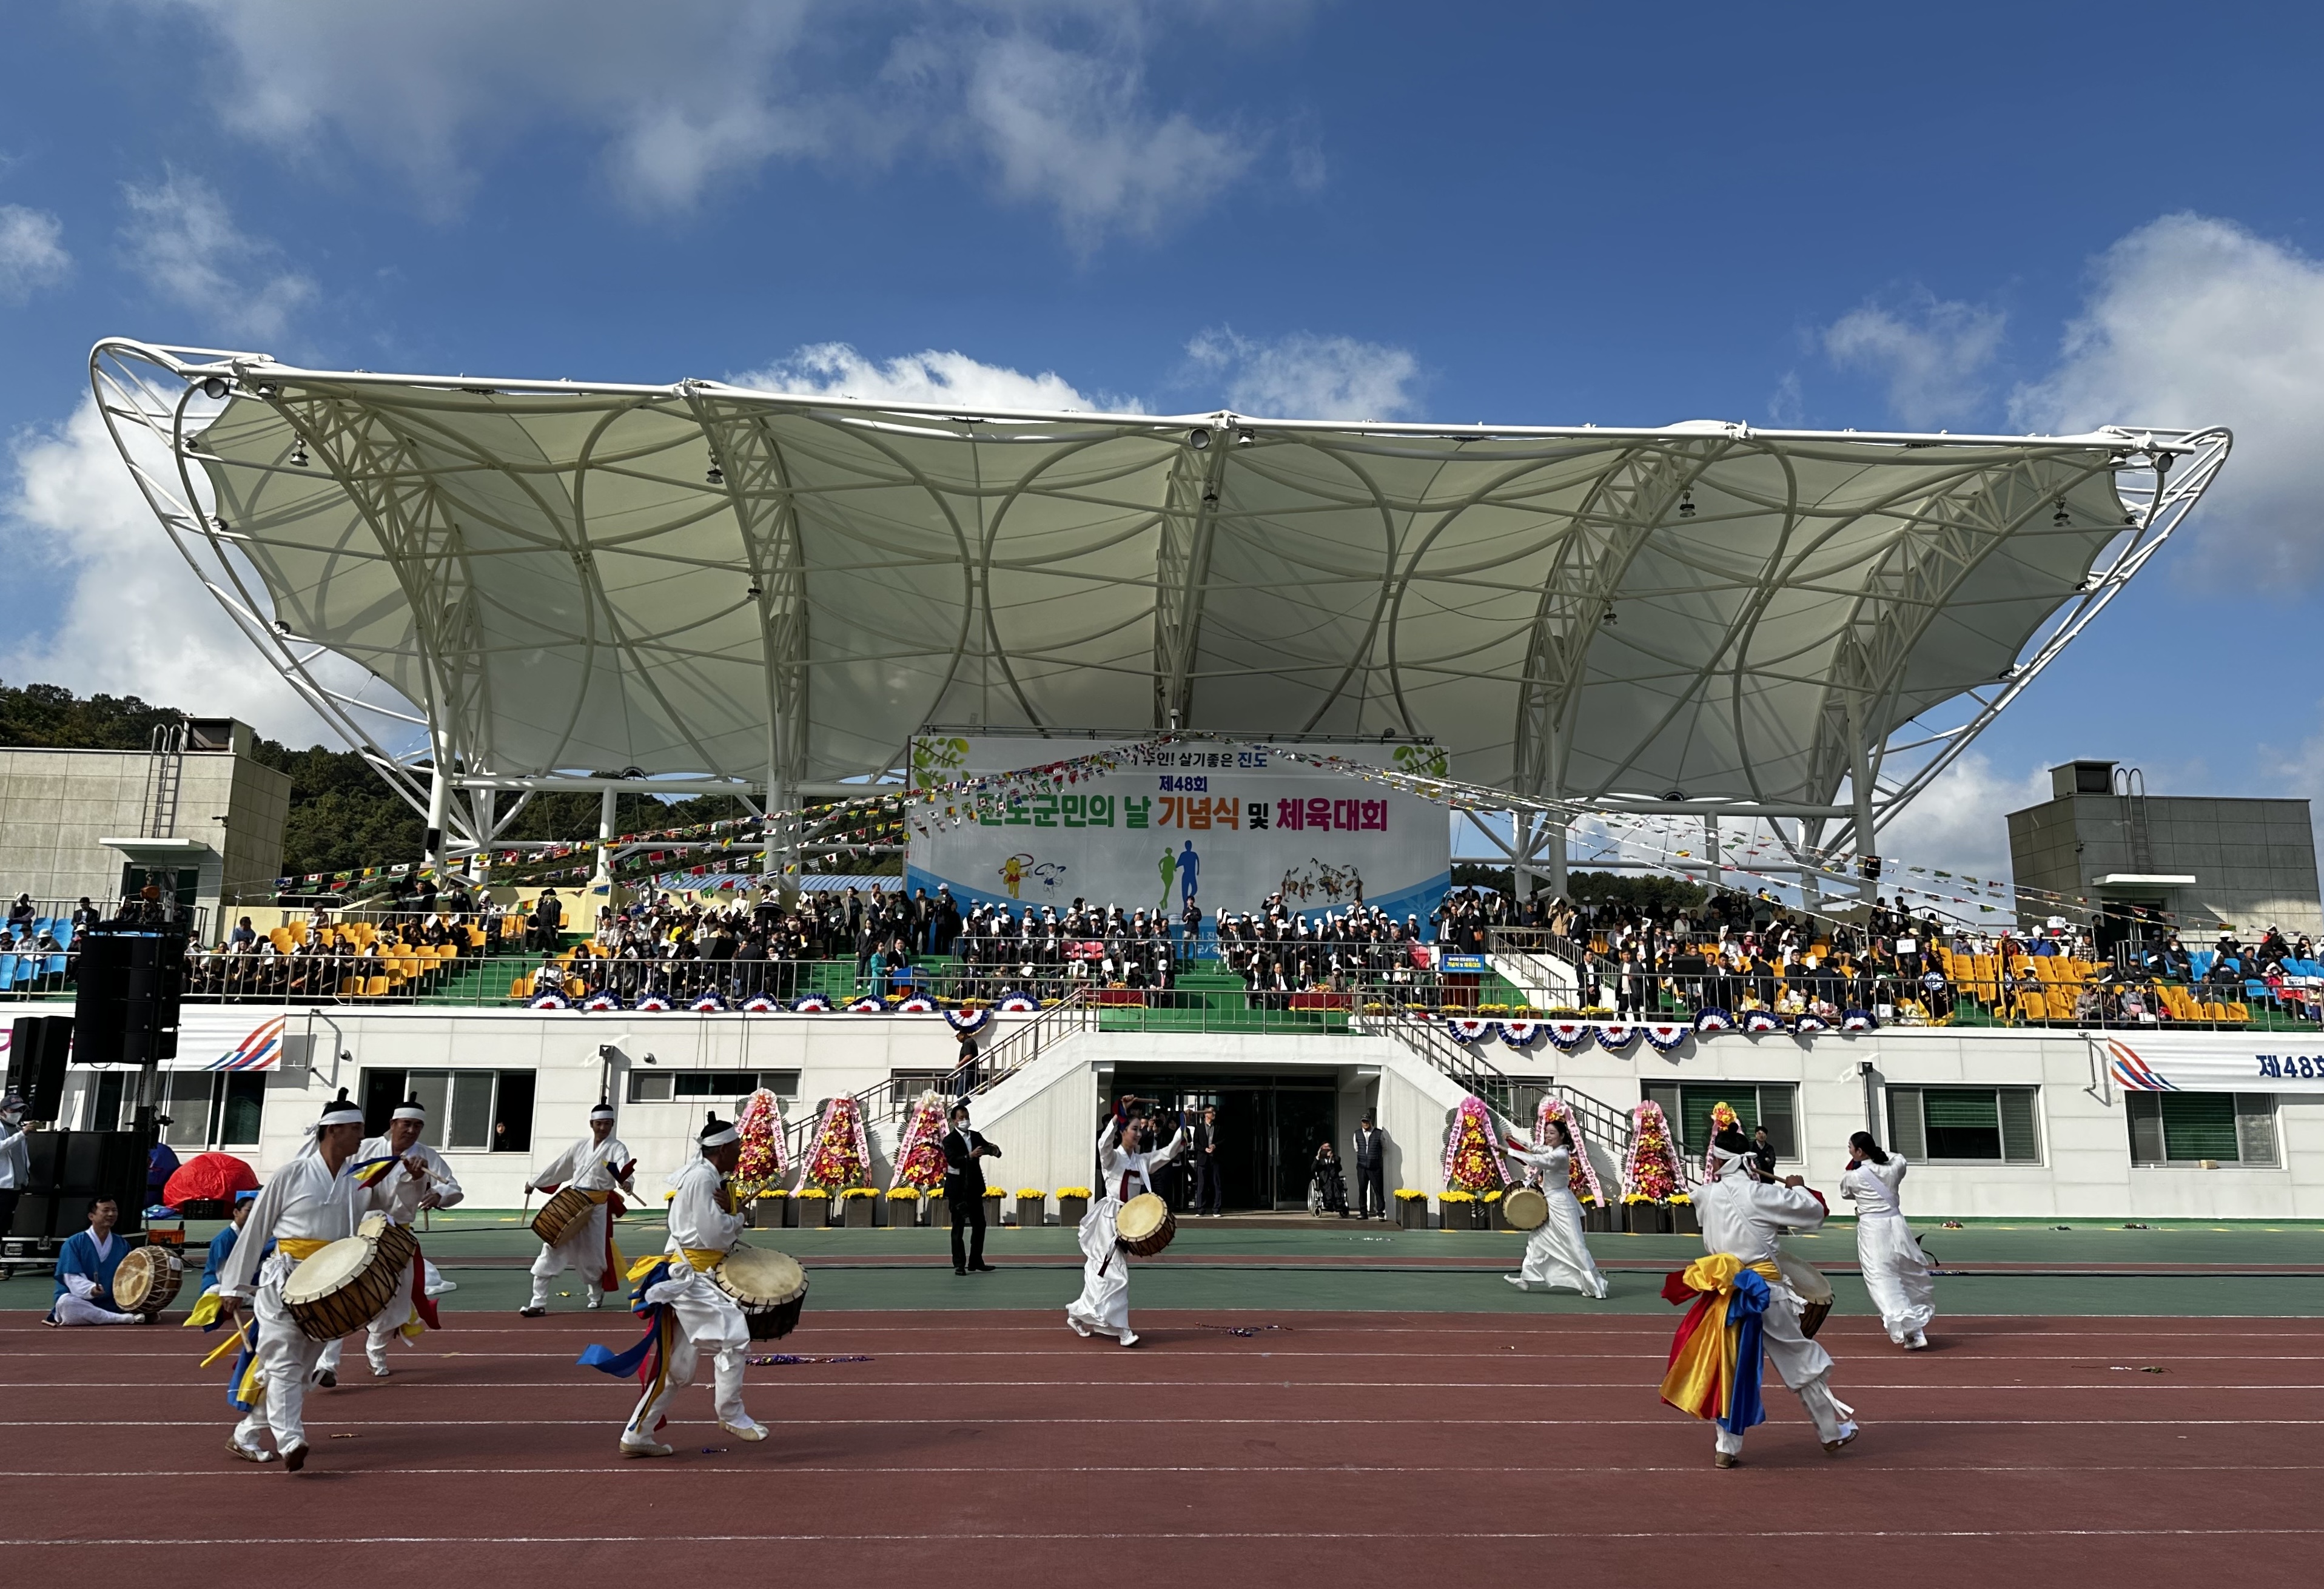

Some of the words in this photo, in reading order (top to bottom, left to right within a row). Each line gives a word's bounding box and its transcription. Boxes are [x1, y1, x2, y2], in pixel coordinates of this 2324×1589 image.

[1178, 752, 1233, 767] 살기좋은
[1237, 752, 1268, 768] 진도
[1159, 775, 1208, 793] 제48회
[1124, 796, 1152, 828] 날
[1157, 796, 1240, 830] 기념식
[1248, 802, 1269, 830] 및
[1276, 798, 1388, 832] 체육대회
